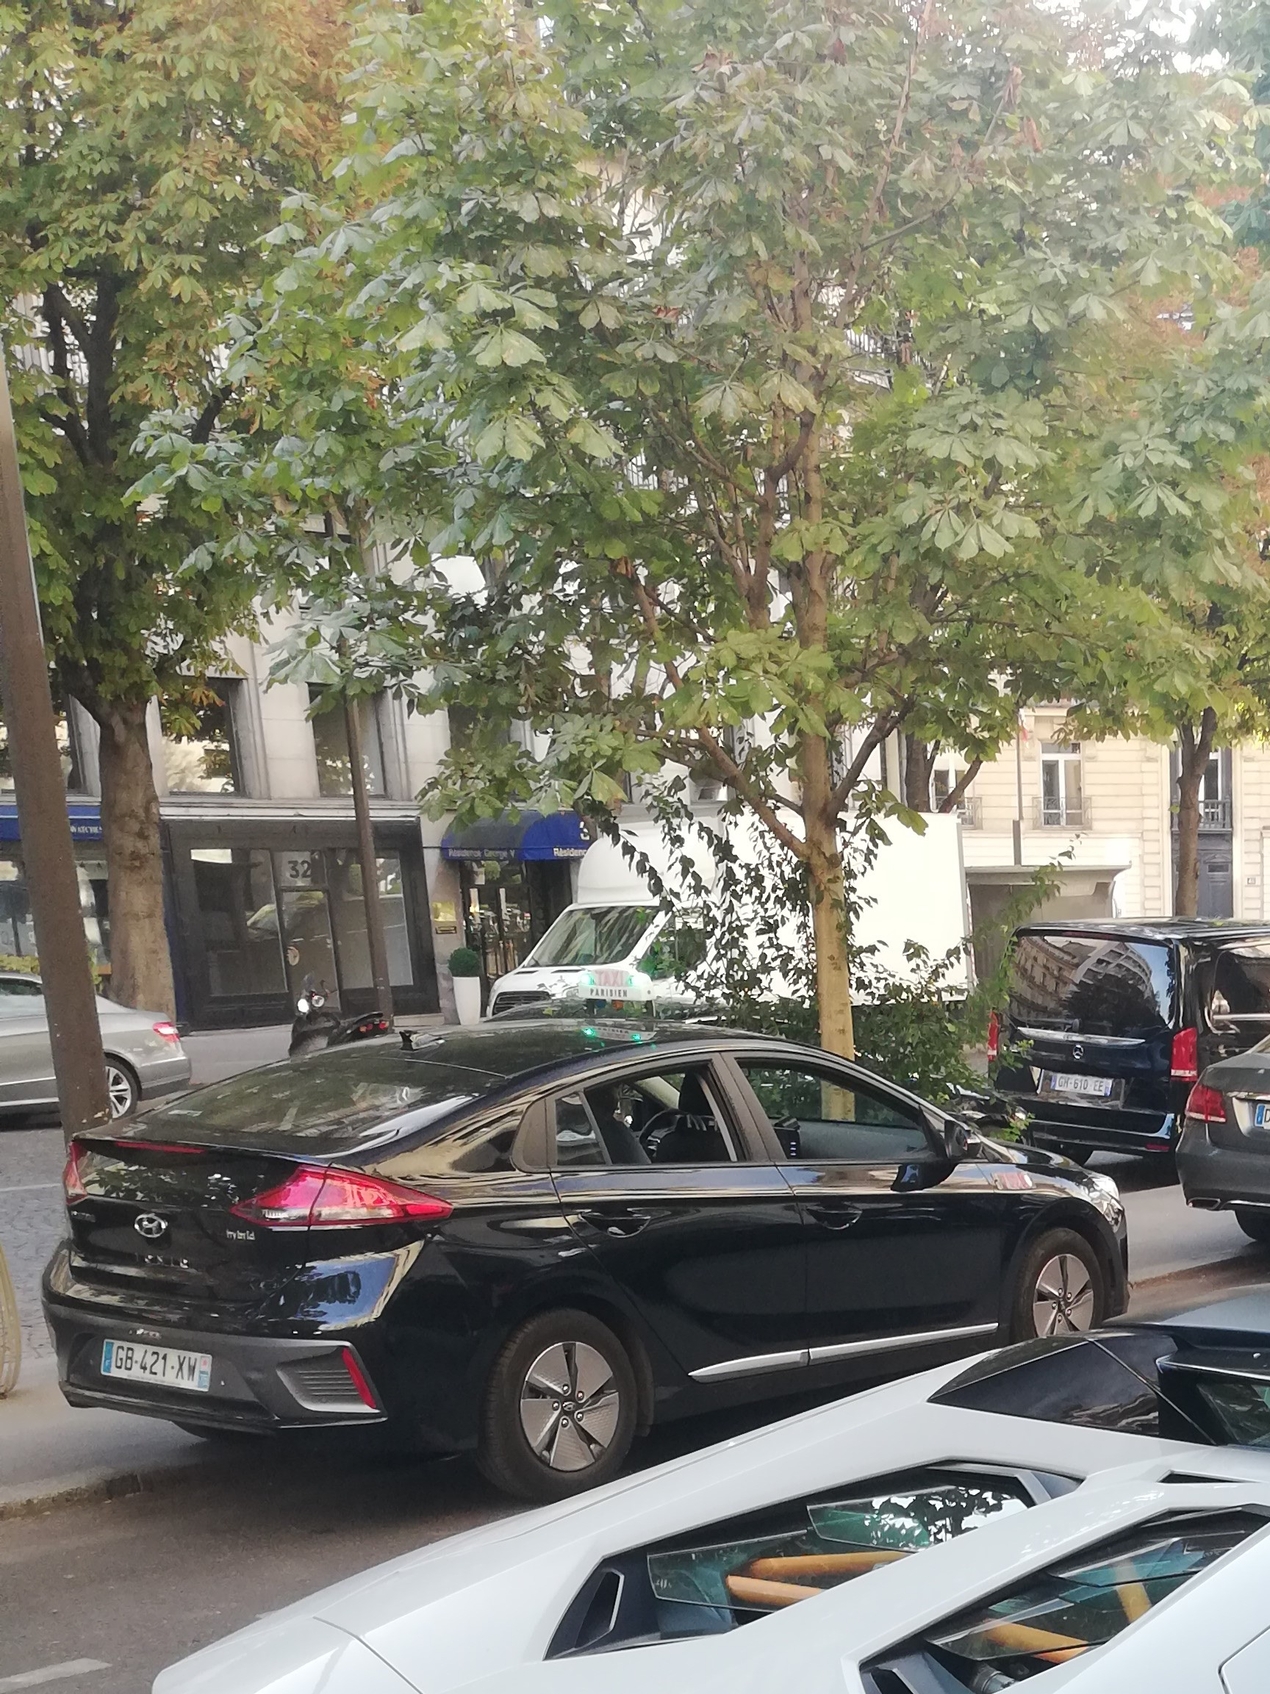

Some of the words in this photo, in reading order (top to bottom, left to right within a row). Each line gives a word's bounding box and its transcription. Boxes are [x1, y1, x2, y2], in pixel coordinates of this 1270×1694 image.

[288, 860, 311, 878] 32
[595, 969, 624, 986] TAXI
[590, 989, 628, 997] PARISIEN
[115, 1345, 198, 1382] GB-421-XW
